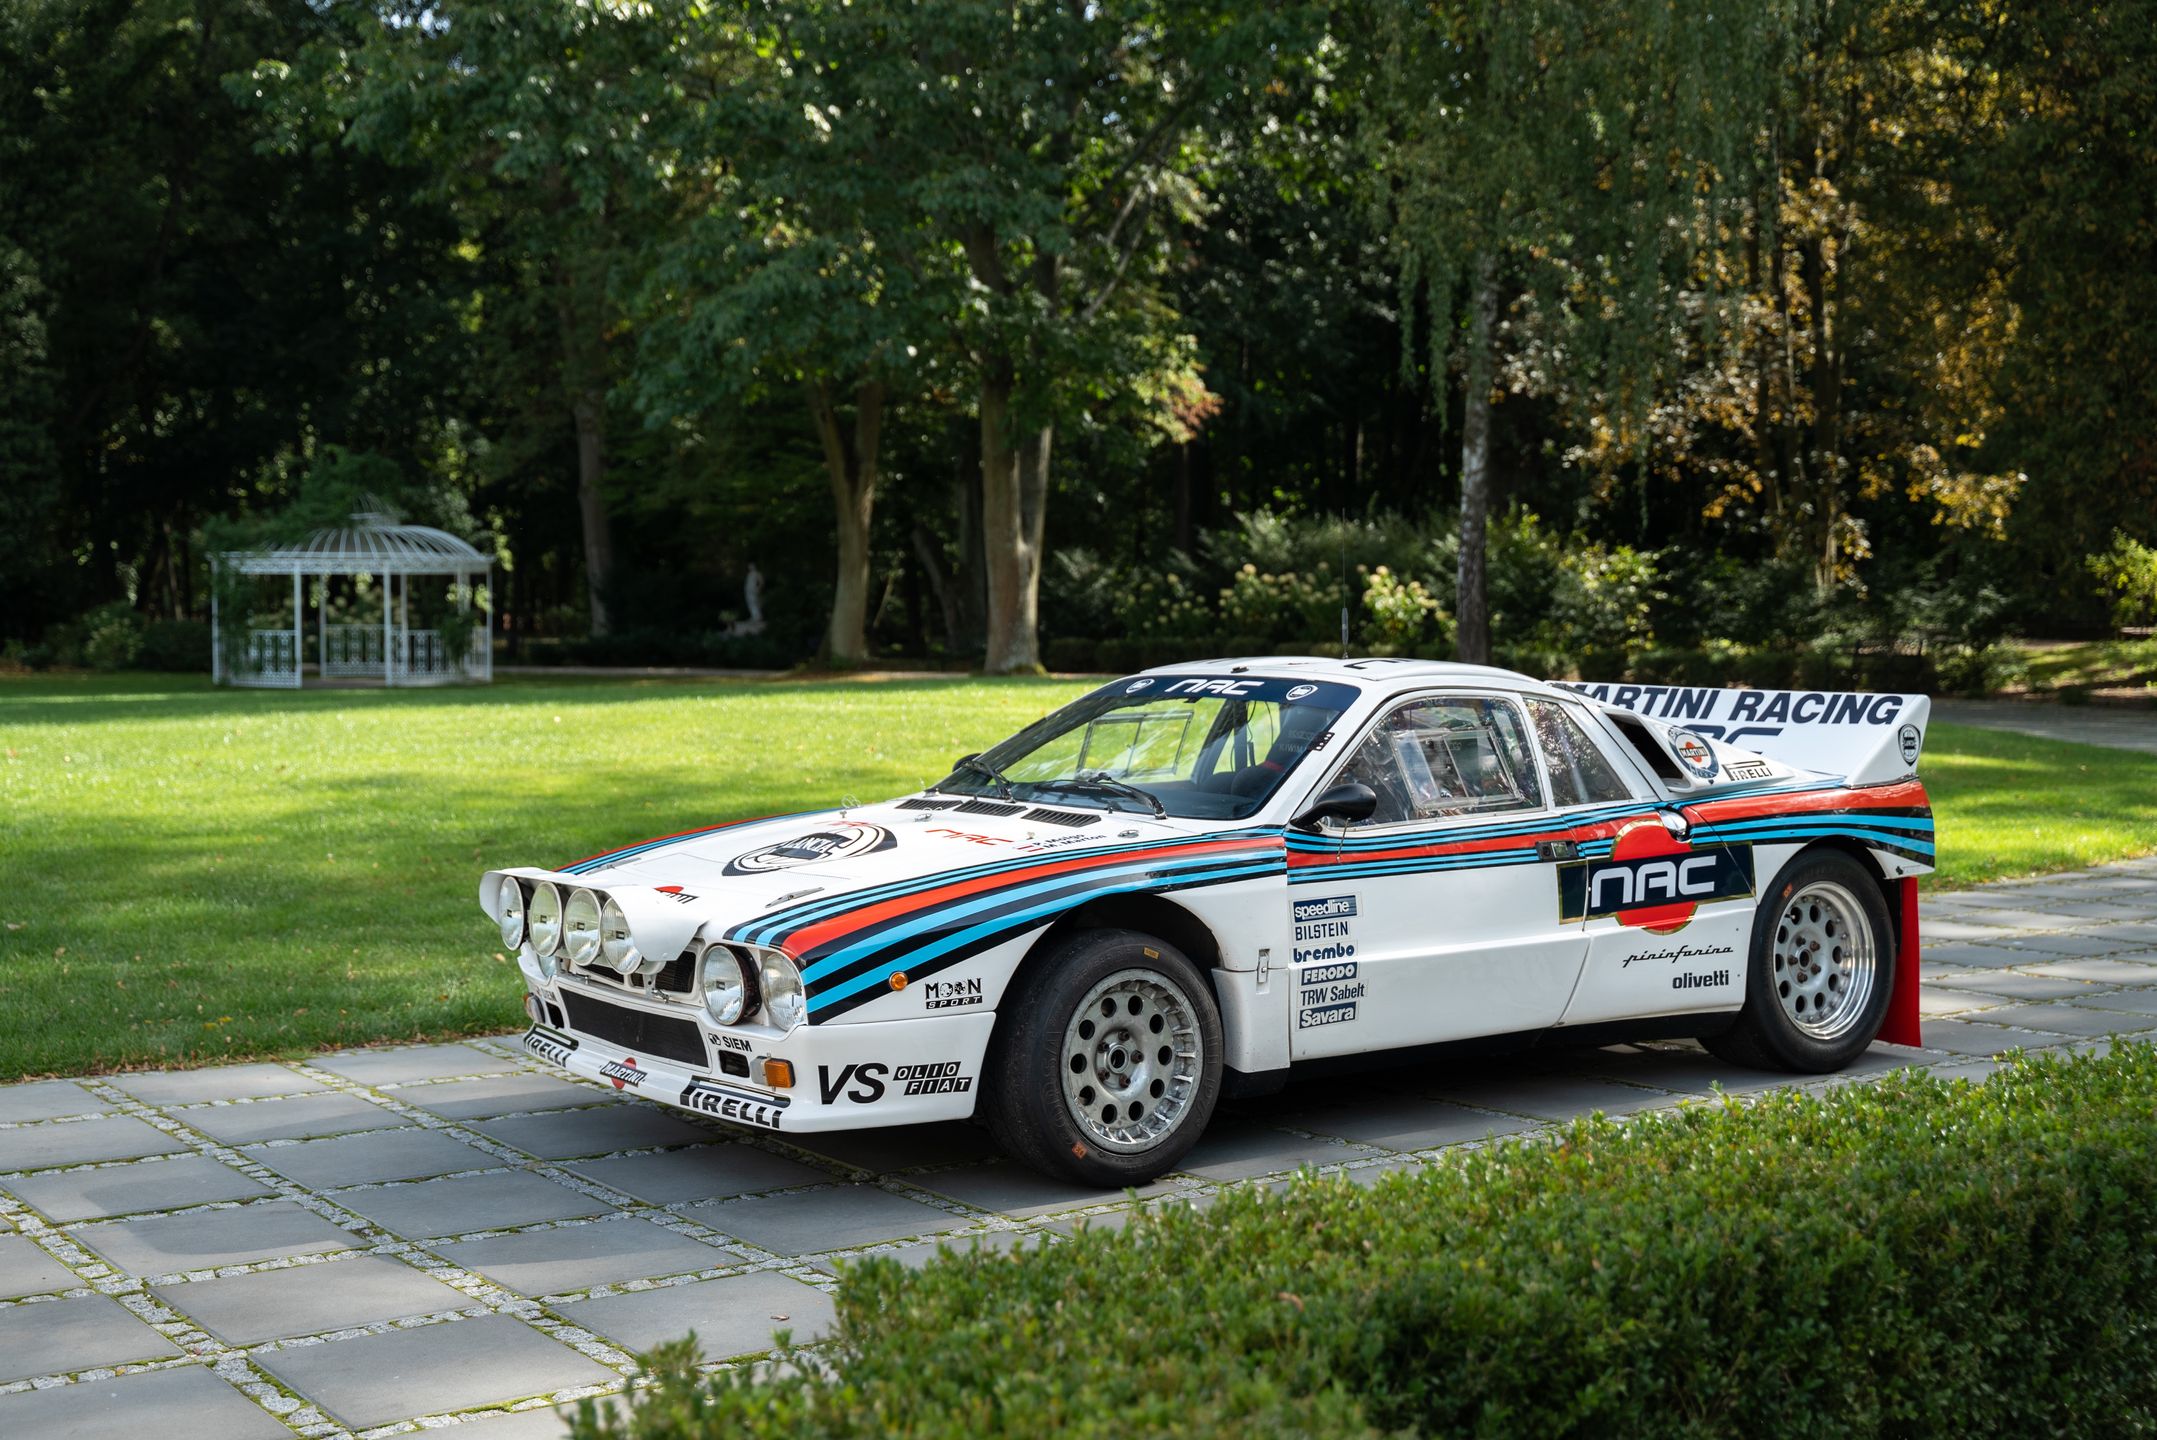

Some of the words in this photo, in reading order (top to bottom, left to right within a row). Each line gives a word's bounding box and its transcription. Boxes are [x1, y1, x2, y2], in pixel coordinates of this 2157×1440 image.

[1727, 691, 1904, 725] RACING
[1721, 760, 1773, 781] PIRELLI
[1294, 899, 1350, 920] speedline
[1294, 920, 1349, 941] BILSTEIN
[1293, 942, 1355, 963] brembo
[1622, 944, 1734, 968] pininfarina
[1303, 964, 1355, 984] FERODO
[1672, 969, 1730, 989] olivetti
[925, 977, 983, 1001] MOON
[1300, 987, 1328, 1006] TRW
[1330, 982, 1365, 1002] Sabelt
[927, 996, 982, 1009] SPORT
[1301, 1007, 1354, 1027] Savara
[523, 1022, 579, 1068] PIRELLI
[722, 1035, 753, 1053] SIEM
[601, 1062, 646, 1085] MARTINI
[817, 1062, 889, 1105] VS
[896, 1063, 959, 1080] OLIO
[907, 1078, 970, 1094] FIAT
[680, 1075, 791, 1129] PIRELLI
